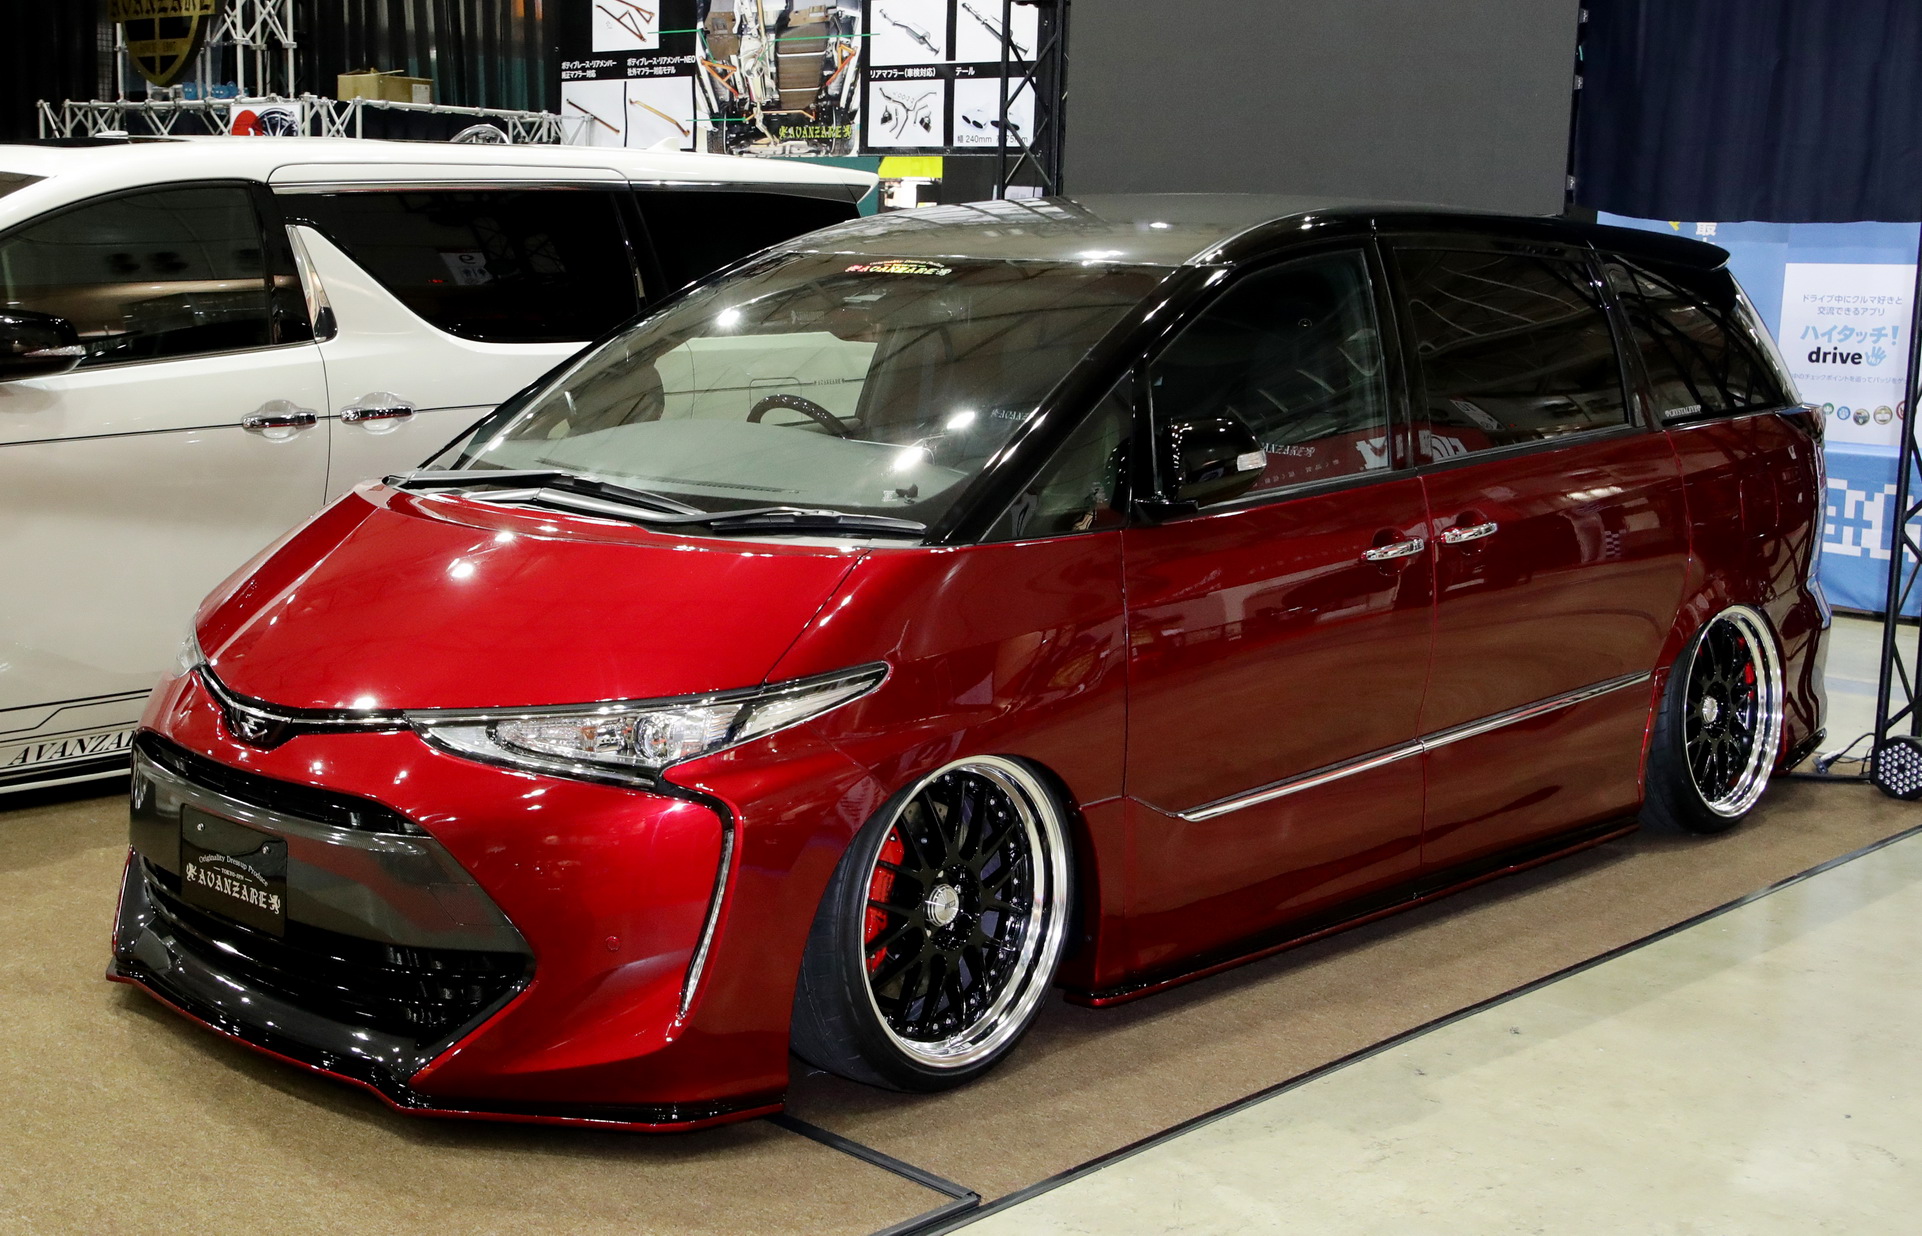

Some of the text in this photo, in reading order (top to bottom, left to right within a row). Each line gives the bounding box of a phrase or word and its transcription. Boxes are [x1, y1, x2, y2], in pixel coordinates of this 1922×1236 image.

[955, 67, 975, 76] テール
[965, 135, 992, 144] 240mm
[1802, 294, 1903, 305] ドライブ中にクルマ好きと
[1817, 306, 1885, 316] 交流できるアプリ
[1807, 346, 1863, 365] drive
[198, 868, 268, 909] AVANZARE
